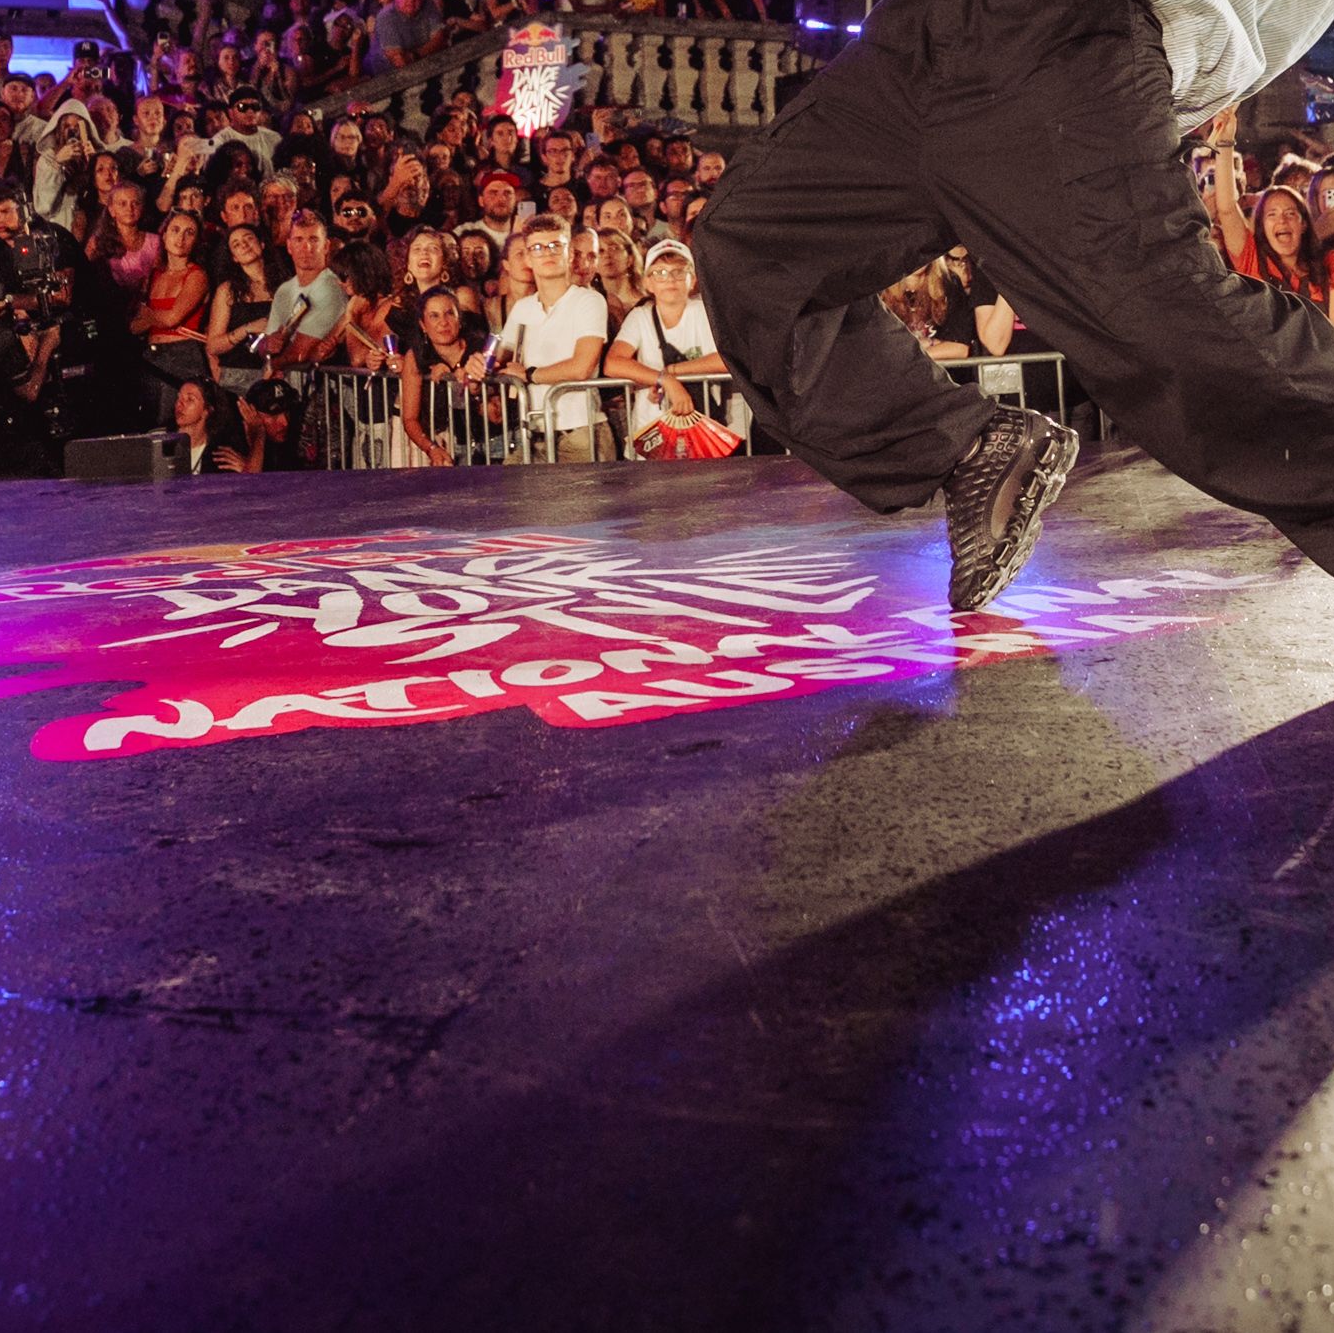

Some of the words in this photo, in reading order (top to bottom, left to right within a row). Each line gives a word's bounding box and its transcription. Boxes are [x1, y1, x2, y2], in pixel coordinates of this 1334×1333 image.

[504, 48, 534, 66] Red
[536, 46, 565, 64] Bull
[509, 66, 560, 94] DANCE
[514, 81, 564, 108] YOUR
[112, 548, 634, 620] DANCE
[323, 568, 879, 665] STYLE
[83, 624, 921, 751] NATIONAL
[555, 613, 1217, 721] AUSTRIA
